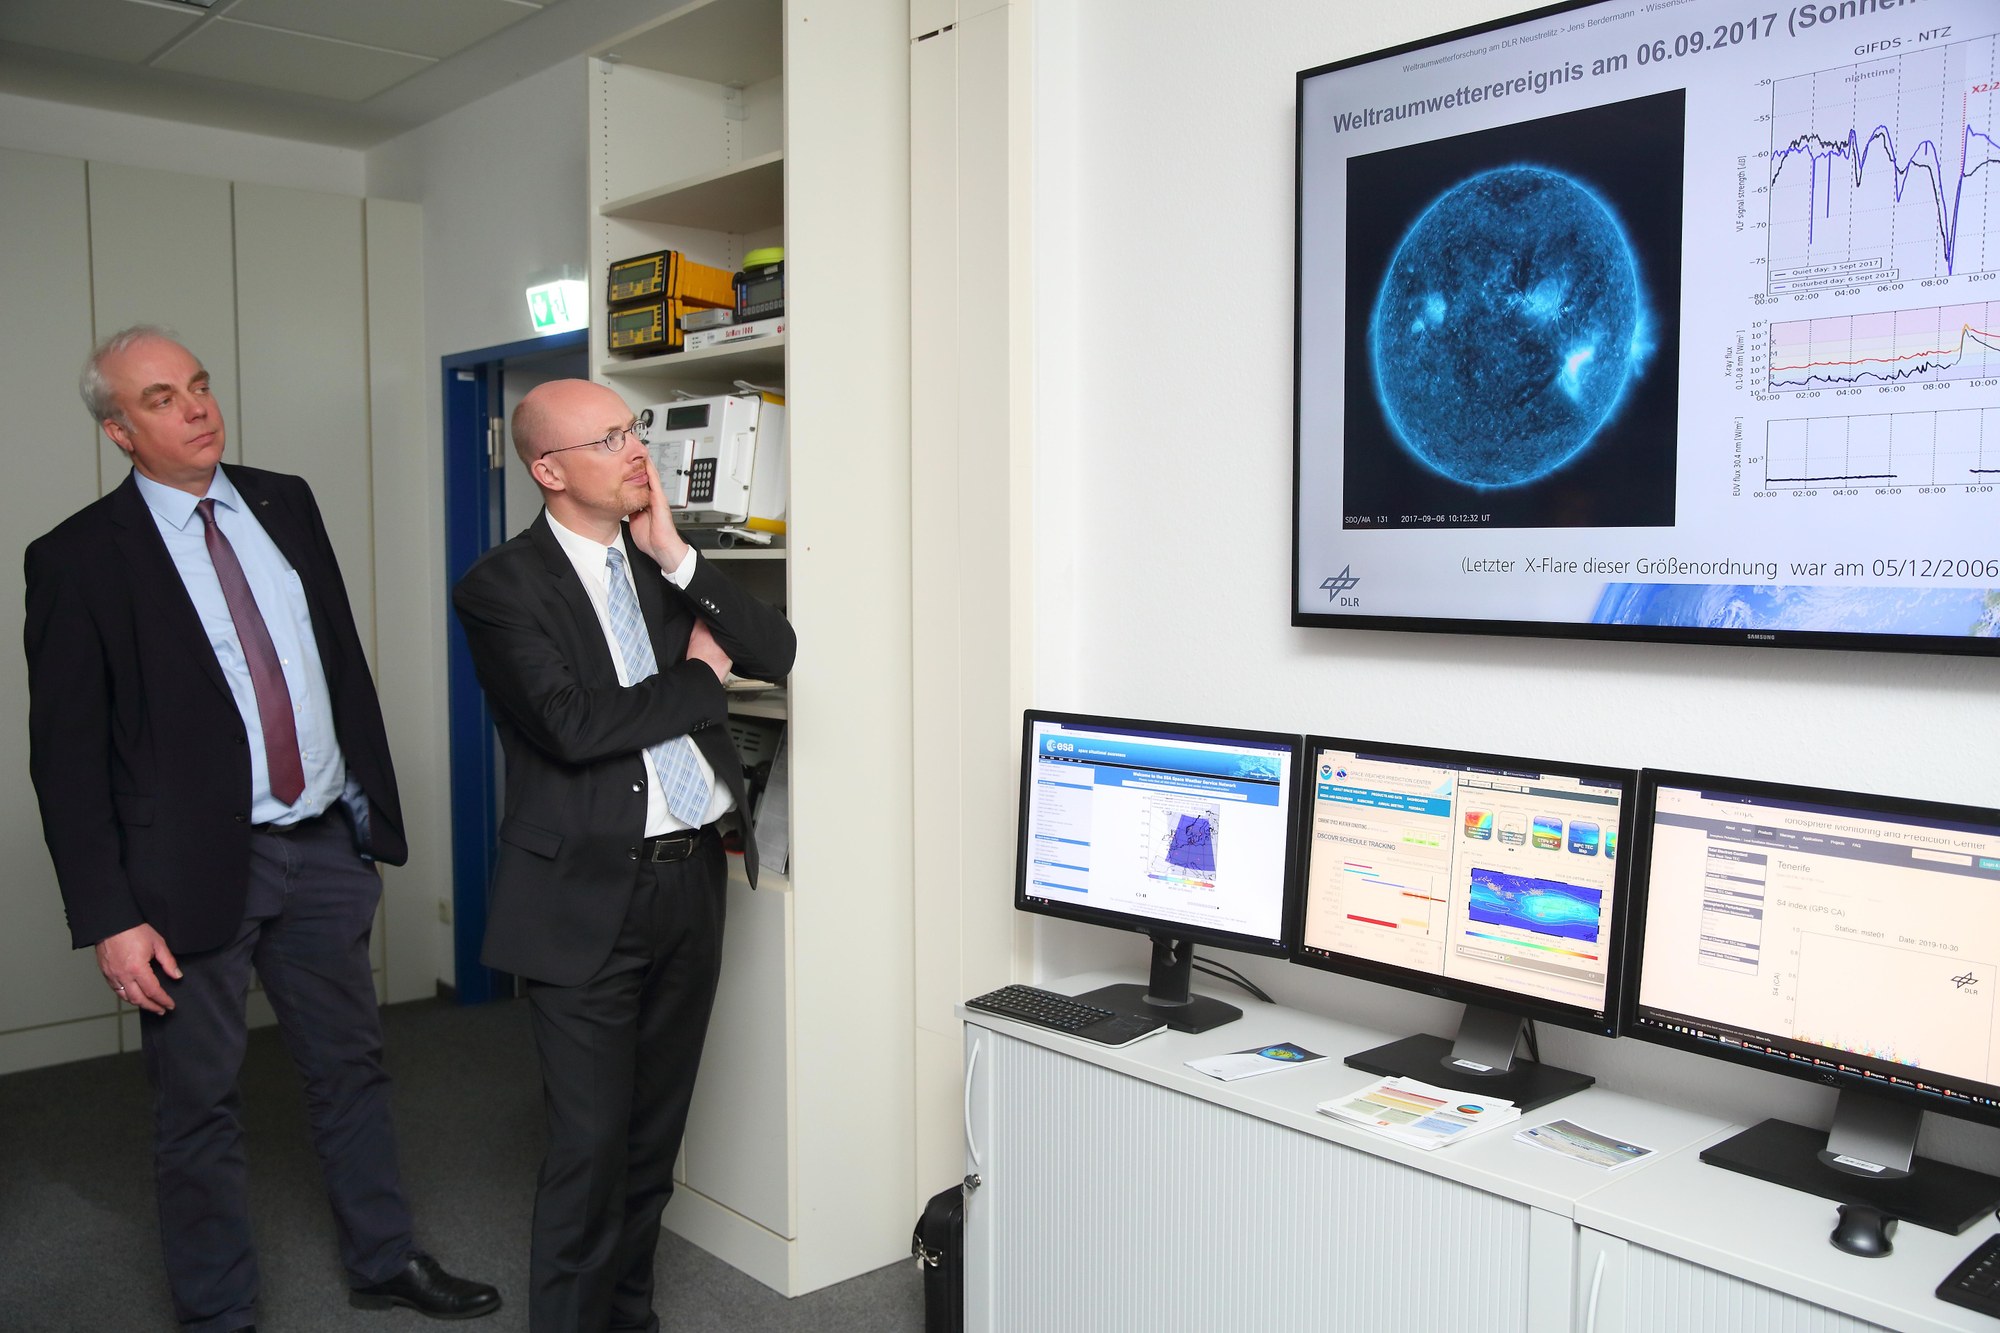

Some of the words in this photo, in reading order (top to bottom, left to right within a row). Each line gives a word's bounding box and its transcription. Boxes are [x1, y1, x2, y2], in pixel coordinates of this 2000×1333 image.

[1402, 46, 1488, 73] Weltraumwetterforschung
[1488, 44, 1500, 53] am
[1501, 38, 1518, 49] DLR
[1519, 29, 1558, 45] Neustrelitz
[1566, 22, 1585, 33] Jens
[1587, 9, 1635, 28] Berdermann
[1854, 37, 1901, 56] GIFDS
[1918, 26, 1952, 42] NTZ
[1333, 61, 1584, 134] Weltraumwetterereignis
[1591, 52, 1628, 76] am
[1637, 12, 1778, 66] 06.09.2017
[1844, 67, 1895, 83] nighttime
[1737, 171, 1747, 199] strength
[1736, 199, 1747, 219] signal
[1736, 219, 1744, 233] VLF
[1792, 267, 1812, 276] Quiet
[1814, 265, 1830, 275] day:
[1839, 262, 1856, 271] Sept
[1858, 260, 1879, 268] 2017
[1791, 278, 1828, 289] Disturbed
[1829, 276, 1846, 286] day:
[1854, 273, 1873, 283] Sept
[1875, 271, 1895, 279] 2017
[1754, 297, 1779, 306] 00:00
[1794, 292, 1819, 301] 02:00
[1834, 288, 1861, 297] 04:00
[1877, 283, 1904, 293] 06:00
[1920, 278, 1949, 288] 08:00
[1967, 273, 1997, 282] 10:00
[1725, 346, 1733, 359] flux
[1725, 361, 1734, 377] X-ray
[1737, 355, 1744, 367] nm
[1735, 367, 1744, 390] 0.1-0.8
[1756, 394, 1780, 402] 00:00
[1796, 390, 1821, 399] 02:00
[1836, 387, 1862, 397] 04:00
[1878, 384, 1906, 394] 06:00
[1922, 381, 1951, 391] 08:00
[1968, 378, 1998, 388] 10:00
[1735, 441, 1742, 453] nm
[1733, 454, 1741, 468] 30.4
[1733, 469, 1741, 482] flux
[1732, 483, 1741, 497] EUV
[1832, 488, 1859, 497] 04:00
[1875, 486, 1902, 496] 06:00
[1918, 485, 1946, 495] 08:00
[1964, 485, 1994, 494] 10:00
[1344, 515, 1371, 525] SDO/AIA
[1376, 515, 1388, 523] 131
[1400, 515, 1445, 523] 2017-09-06
[1448, 514, 1479, 522] 10:12:32
[1481, 514, 1491, 522] UT
[1461, 556, 1516, 575] (Letzter
[1524, 557, 1578, 574] X-Flare
[1583, 557, 1631, 575] dieser
[1636, 557, 1778, 580] Größenordnung
[1790, 562, 1827, 577] war
[1833, 562, 1864, 577] am
[1872, 559, 2000, 578] 05/12/2006
[1340, 597, 1360, 607] DLR
[1057, 742, 1074, 752] esa
[1317, 832, 1339, 843] DSCOVR
[1339, 835, 1368, 848] SCHEDULE
[1368, 839, 1396, 851] TRACKING
[1776, 860, 1811, 874] Tenerife
[1776, 899, 1787, 907] S4
[1788, 901, 1808, 912] index
[1809, 904, 1829, 915] (GPS
[1830, 907, 1846, 918] CA)
[1834, 924, 1859, 935] Station:
[1898, 935, 1918, 946] Date:
[1918, 939, 1959, 953] 2019-10-30
[1964, 987, 1979, 996] DLR
